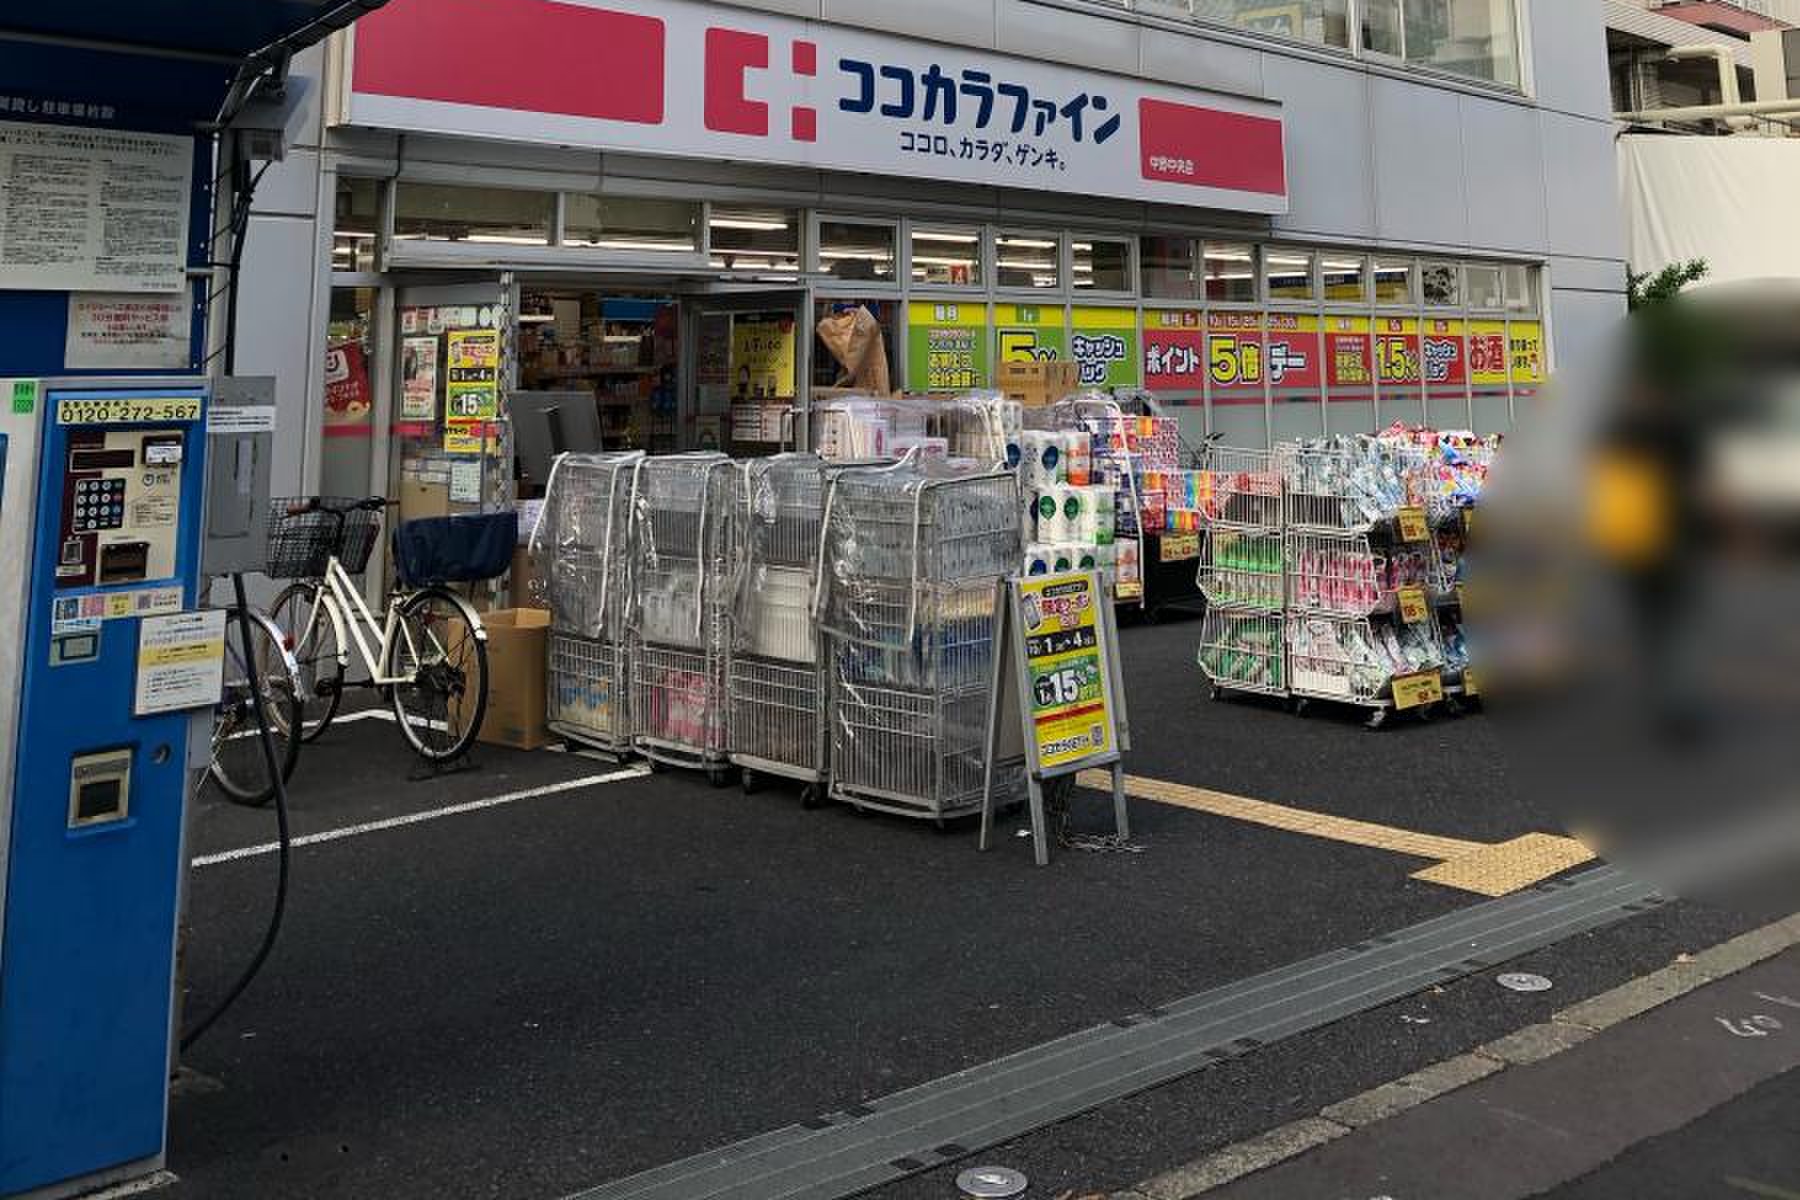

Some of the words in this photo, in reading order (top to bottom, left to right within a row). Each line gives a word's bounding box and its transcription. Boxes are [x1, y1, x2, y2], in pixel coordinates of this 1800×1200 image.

[839, 58, 1121, 144] ココカラファイン
[1146, 343, 1200, 374] ポイント
[61, 406, 198, 424] 0120-272-567
